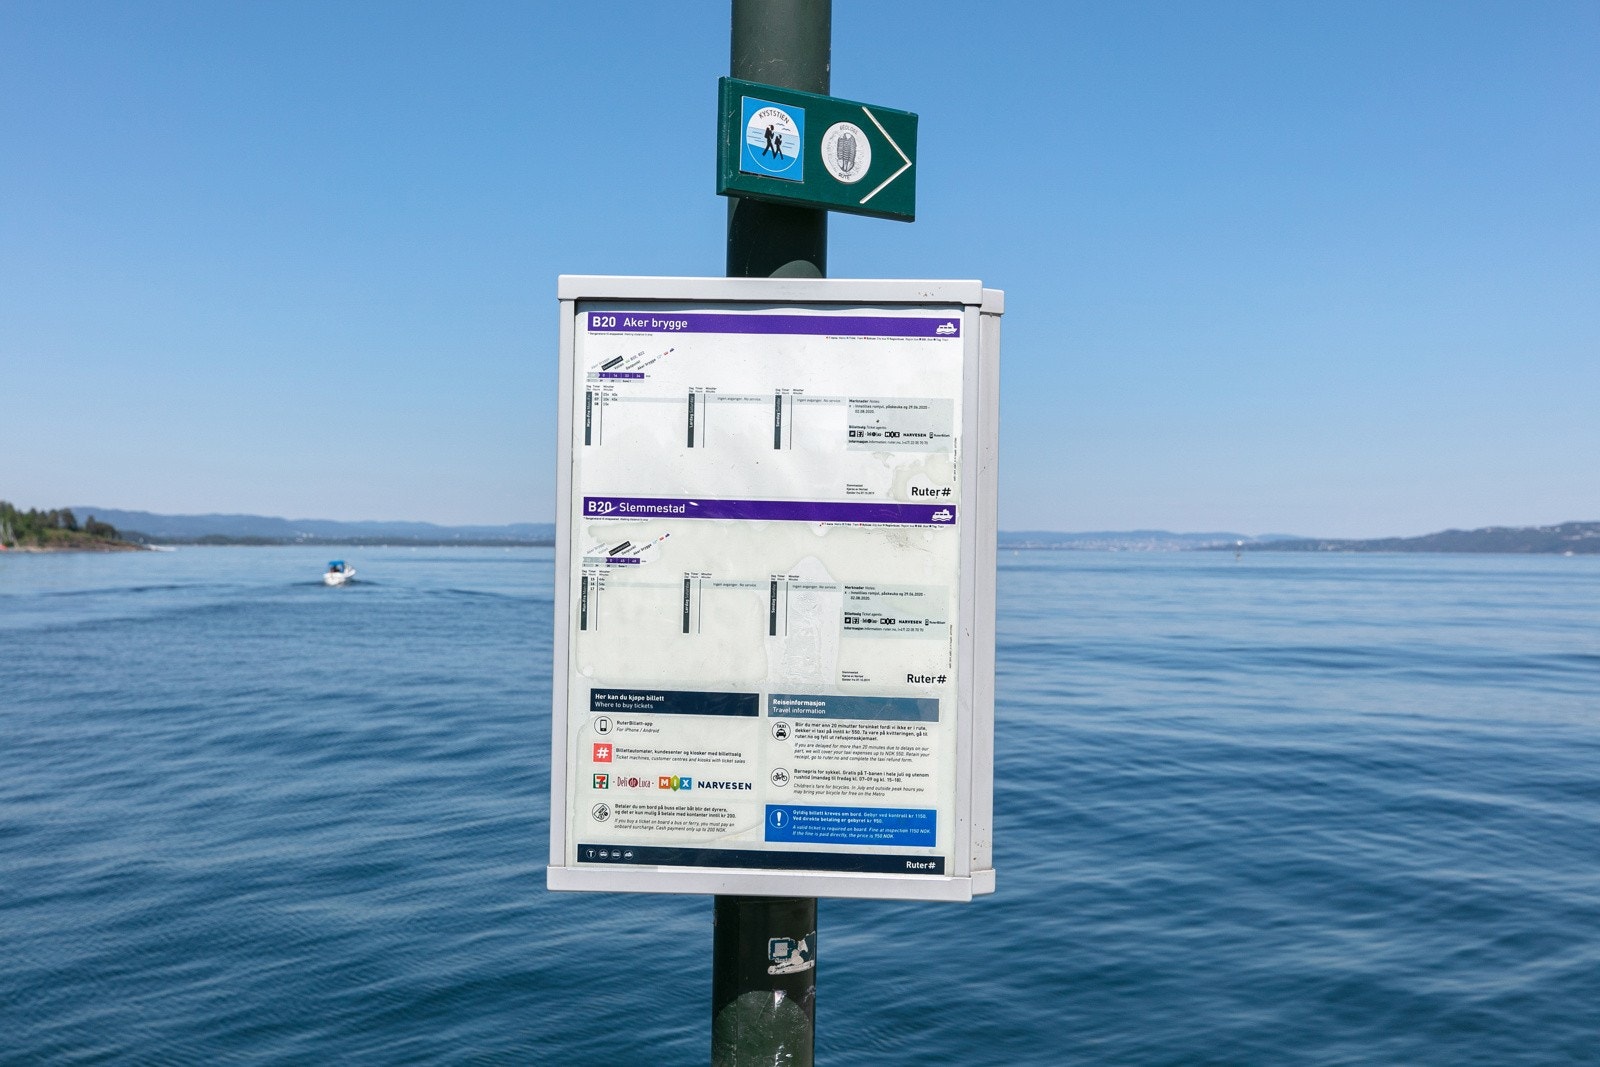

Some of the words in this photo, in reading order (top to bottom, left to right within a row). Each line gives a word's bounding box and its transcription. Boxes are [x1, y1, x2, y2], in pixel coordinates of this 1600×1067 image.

[758, 109, 790, 124] KYSTSTIEN
[592, 315, 616, 328] B20
[623, 317, 649, 327] Aker
[652, 317, 688, 330] brygge
[911, 486, 951, 497] Ruter#
[588, 501, 613, 513] B20
[619, 502, 685, 513] Slemmestad
[907, 673, 947, 684] Ruter#
[628, 694, 645, 702] kjøpe
[772, 699, 826, 708] Reiseinformasjon
[622, 702, 633, 710] buy
[617, 776, 628, 788] Deli
[639, 777, 651, 788] Luca
[659, 778, 691, 790] MIX
[698, 781, 752, 790] NARVESEN
[906, 861, 936, 870] Ruter#
